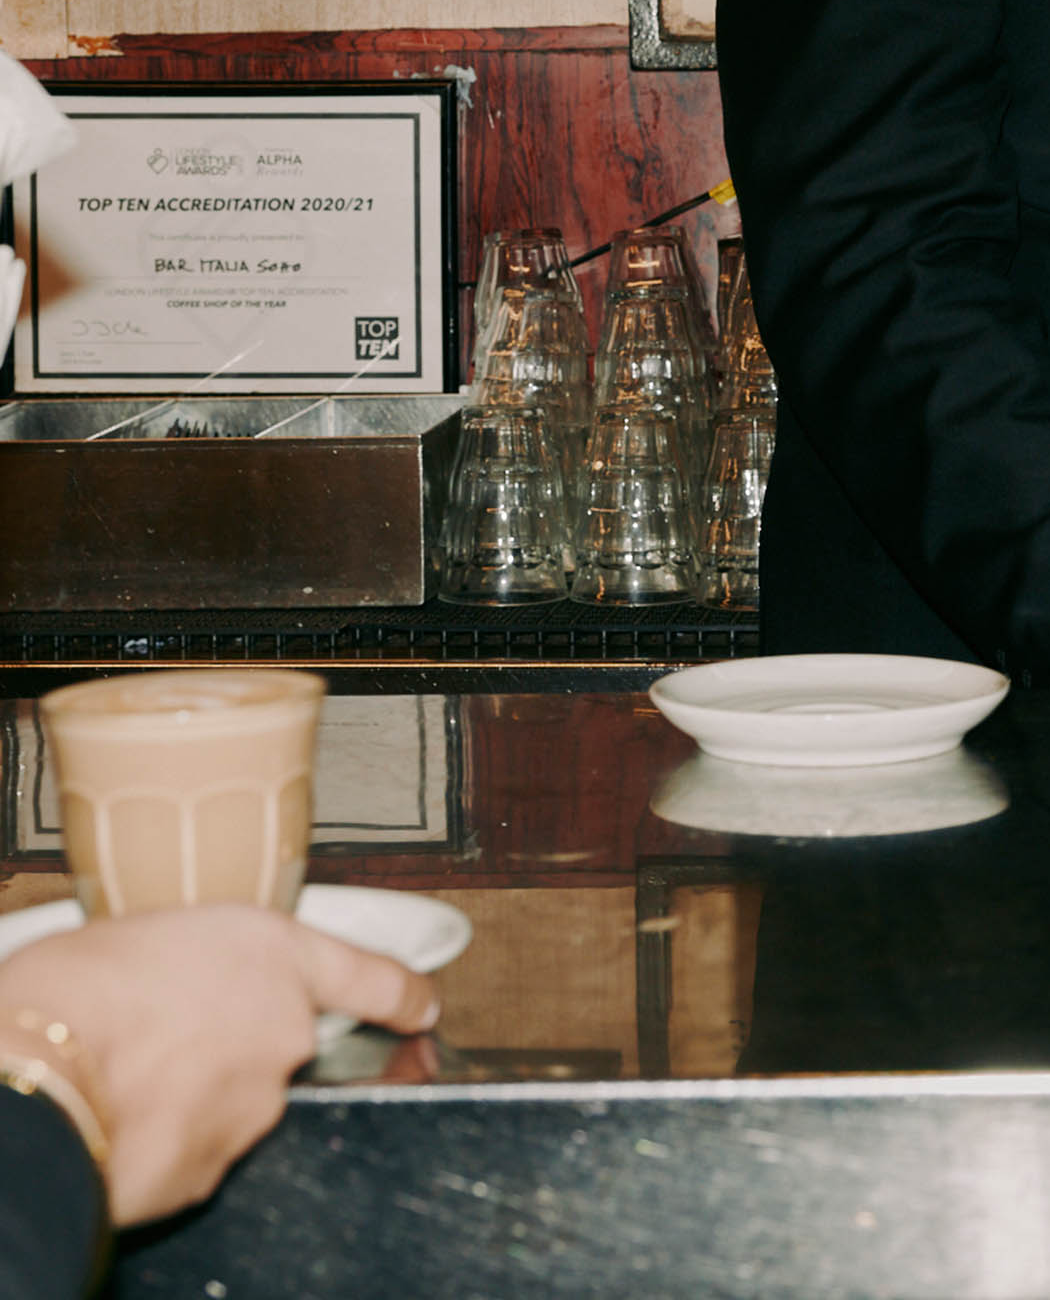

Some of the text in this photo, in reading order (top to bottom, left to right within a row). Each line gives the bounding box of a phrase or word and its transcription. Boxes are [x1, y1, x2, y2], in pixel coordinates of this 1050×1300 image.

[256, 155, 303, 165] ALPHA
[78, 197, 374, 213] TOP TEN ACCREDITATION 2020/21
[154, 258, 194, 273] BAR
[200, 257, 250, 273] ITALIA
[357, 320, 397, 337] TOP
[358, 339, 400, 356] TEN
